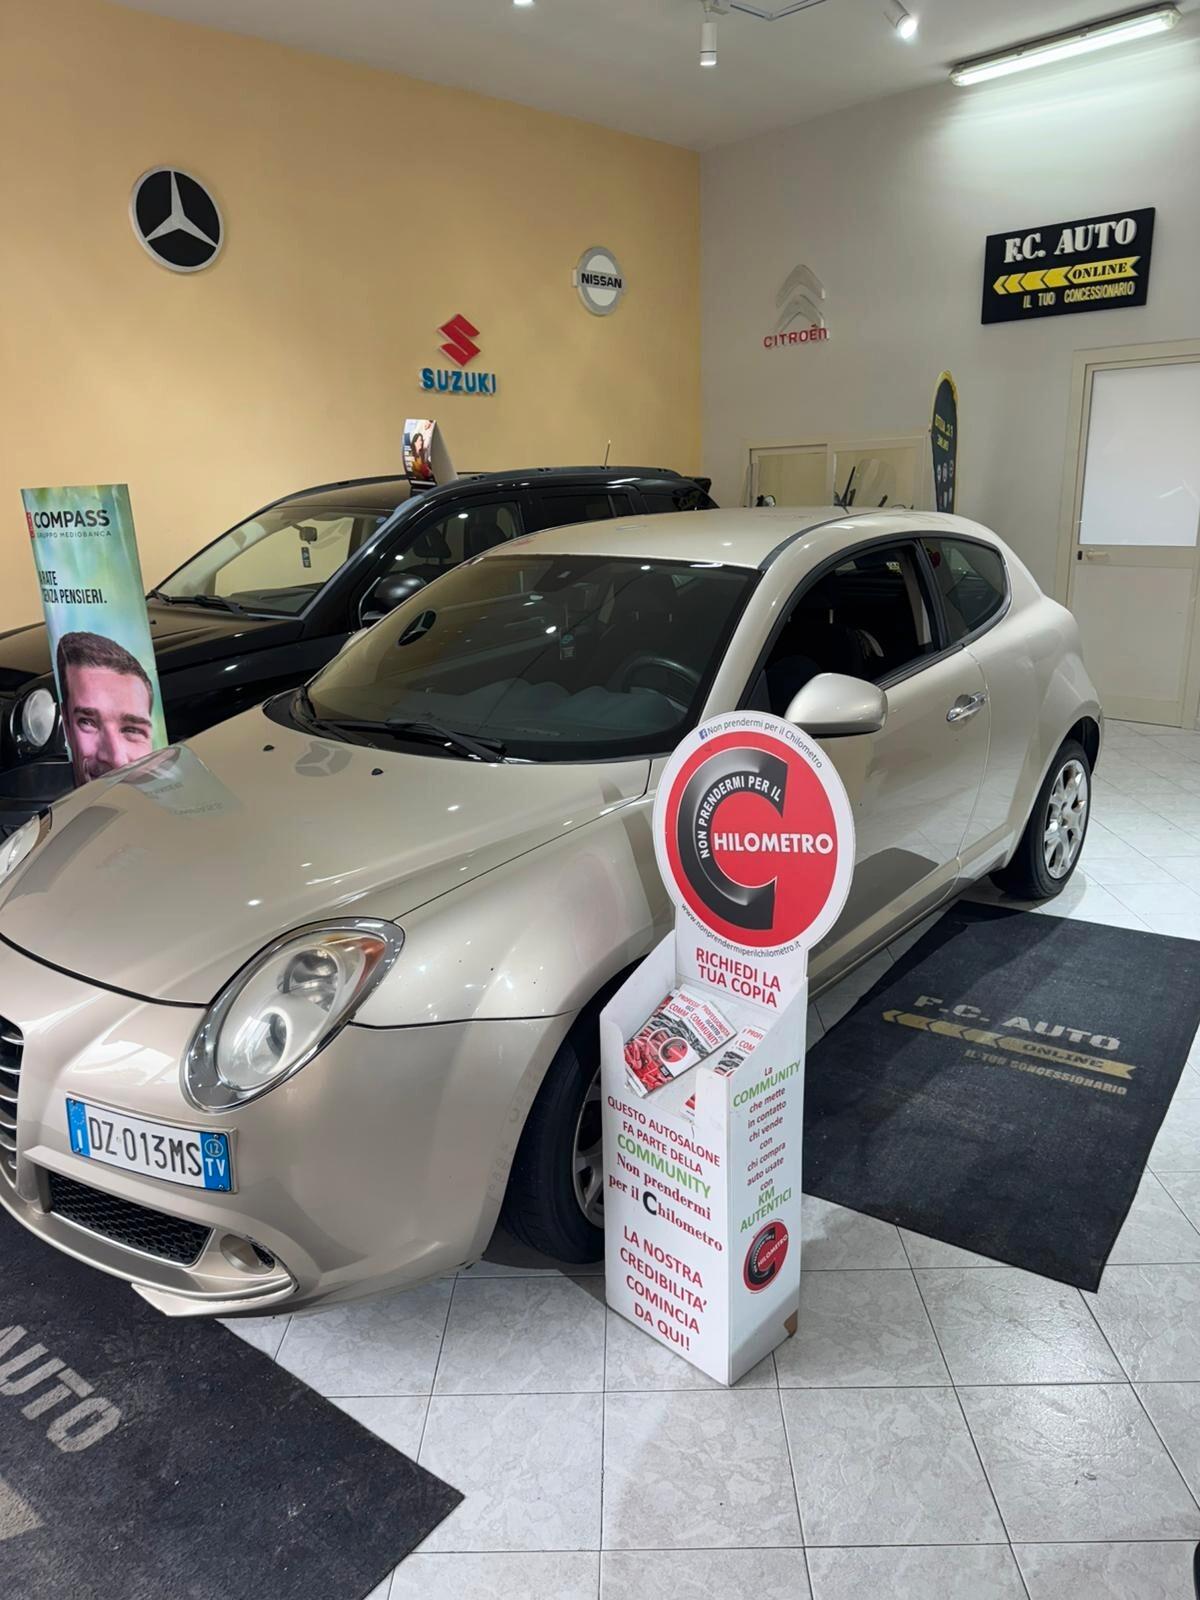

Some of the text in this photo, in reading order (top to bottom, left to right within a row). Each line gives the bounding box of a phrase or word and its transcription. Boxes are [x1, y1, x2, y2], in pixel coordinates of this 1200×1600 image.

[1003, 217, 1138, 263] F.C. AUTO
[581, 272, 622, 289] NISSAN
[1072, 262, 1128, 280] ONLINE
[1022, 281, 1136, 309] IL TUO CONCESSIONARIO
[420, 367, 497, 394] SUZUKI
[33, 509, 111, 529] COMPASS
[60, 530, 112, 539] MEDIOBANCA
[59, 588, 108, 604] PENSIERI.
[707, 724, 723, 736] Non
[723, 718, 764, 730] prendermi
[764, 722, 778, 733] per
[778, 726, 786, 736] il
[785, 730, 823, 769] Chilometro
[698, 775, 782, 859] NON PRENDERMI PER IL
[681, 903, 802, 957] www.nonprendermiperilchilometro.it
[695, 947, 781, 992] RICHIEDI LA
[698, 964, 777, 1008] TUA COPIA
[690, 1013, 720, 1046] COMMUNITY
[914, 994, 1121, 1051] F.C. AUTO
[764, 1066, 773, 1077] La
[1023, 1043, 1105, 1068] ONLINE
[733, 1060, 801, 1108] COMMUNITY
[749, 1087, 785, 1114] che mette
[747, 1100, 787, 1129] in contatto
[749, 1116, 783, 1142] chi vende
[607, 1095, 721, 1168] QUESTO AUTOSALONE
[759, 1137, 773, 1150] con
[623, 1121, 703, 1176] FA PARTE DELLA
[747, 1142, 786, 1172] chi compra
[205, 1158, 226, 1177] TV
[617, 1134, 711, 1199] COMMUNITY
[747, 1157, 784, 1186] auto usate
[617, 1152, 712, 1221] Non prendermi
[758, 1186, 775, 1205] KM
[760, 1178, 773, 1191] con
[608, 1174, 723, 1252] per il Chilometro
[740, 1187, 792, 1233] AUTENTICI
[624, 1225, 703, 1288] LA NOSTRA
[620, 1247, 707, 1313] CREDIBILITA'
[626, 1275, 700, 1335] COMINCIA
[634, 1302, 690, 1351] DA QUI!
